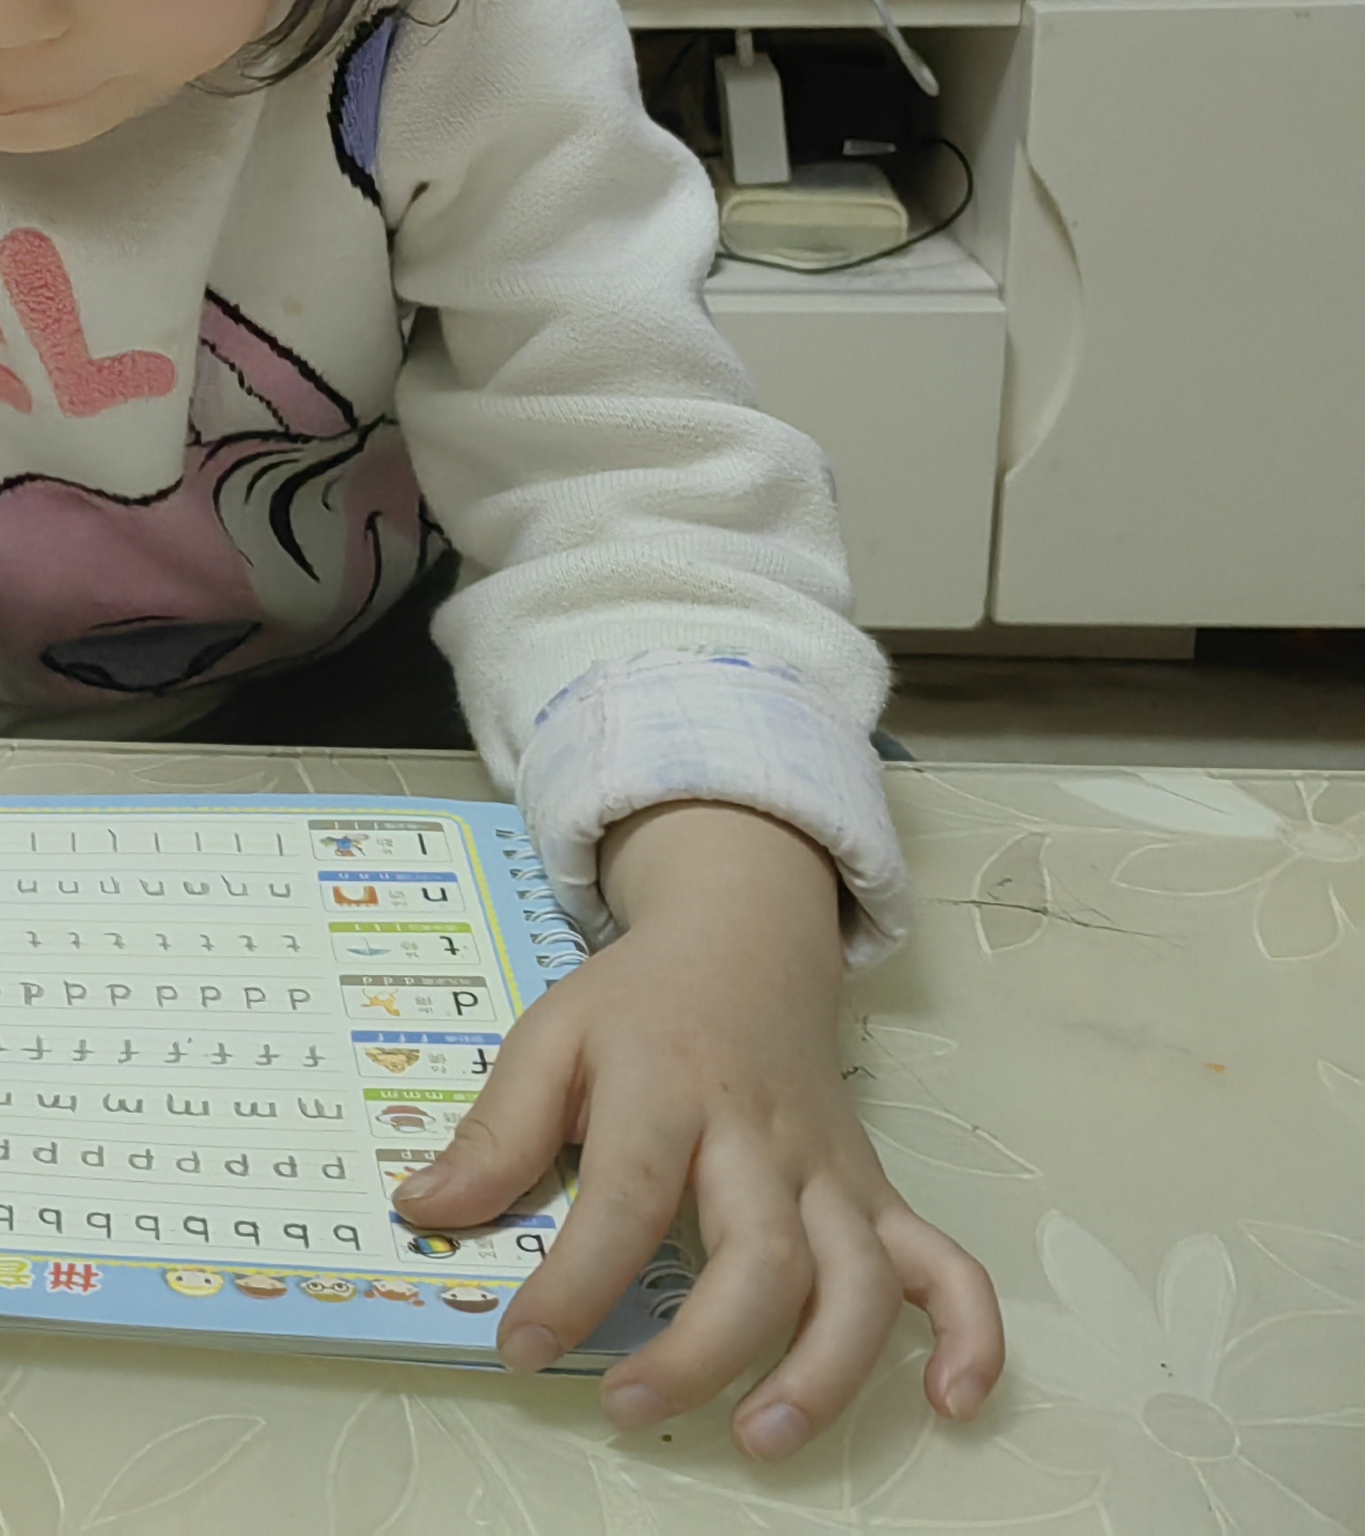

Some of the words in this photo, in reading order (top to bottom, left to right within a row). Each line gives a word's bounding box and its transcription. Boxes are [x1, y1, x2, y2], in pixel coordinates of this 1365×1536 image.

[421, 887, 449, 902] n
[439, 936, 460, 956] t
[19, 982, 44, 1006] d
[63, 980, 87, 1006] d
[105, 984, 131, 1006] d
[156, 986, 178, 1008] d
[200, 986, 221, 1008] d
[243, 987, 266, 1009] d
[287, 988, 311, 1010] d
[451, 991, 479, 1016] d
[471, 1048, 495, 1074] f
[37, 1094, 77, 1113] m
[103, 1094, 143, 1113] m
[167, 1093, 210, 1116] m
[234, 1102, 277, 1118] m
[297, 1098, 343, 1120] m
[33, 1142, 57, 1164] p
[81, 1145, 104, 1167] p
[128, 1148, 154, 1170] p
[176, 1150, 201, 1173] p
[224, 1154, 249, 1176] p
[273, 1156, 298, 1178] p
[321, 1156, 346, 1180] p
[38, 1208, 63, 1234] b
[86, 1212, 111, 1240] b
[135, 1215, 160, 1240] b
[183, 1216, 209, 1243] b
[234, 1220, 260, 1246] b
[283, 1223, 309, 1249] b
[333, 1224, 361, 1251] b
[515, 1234, 547, 1260] b
